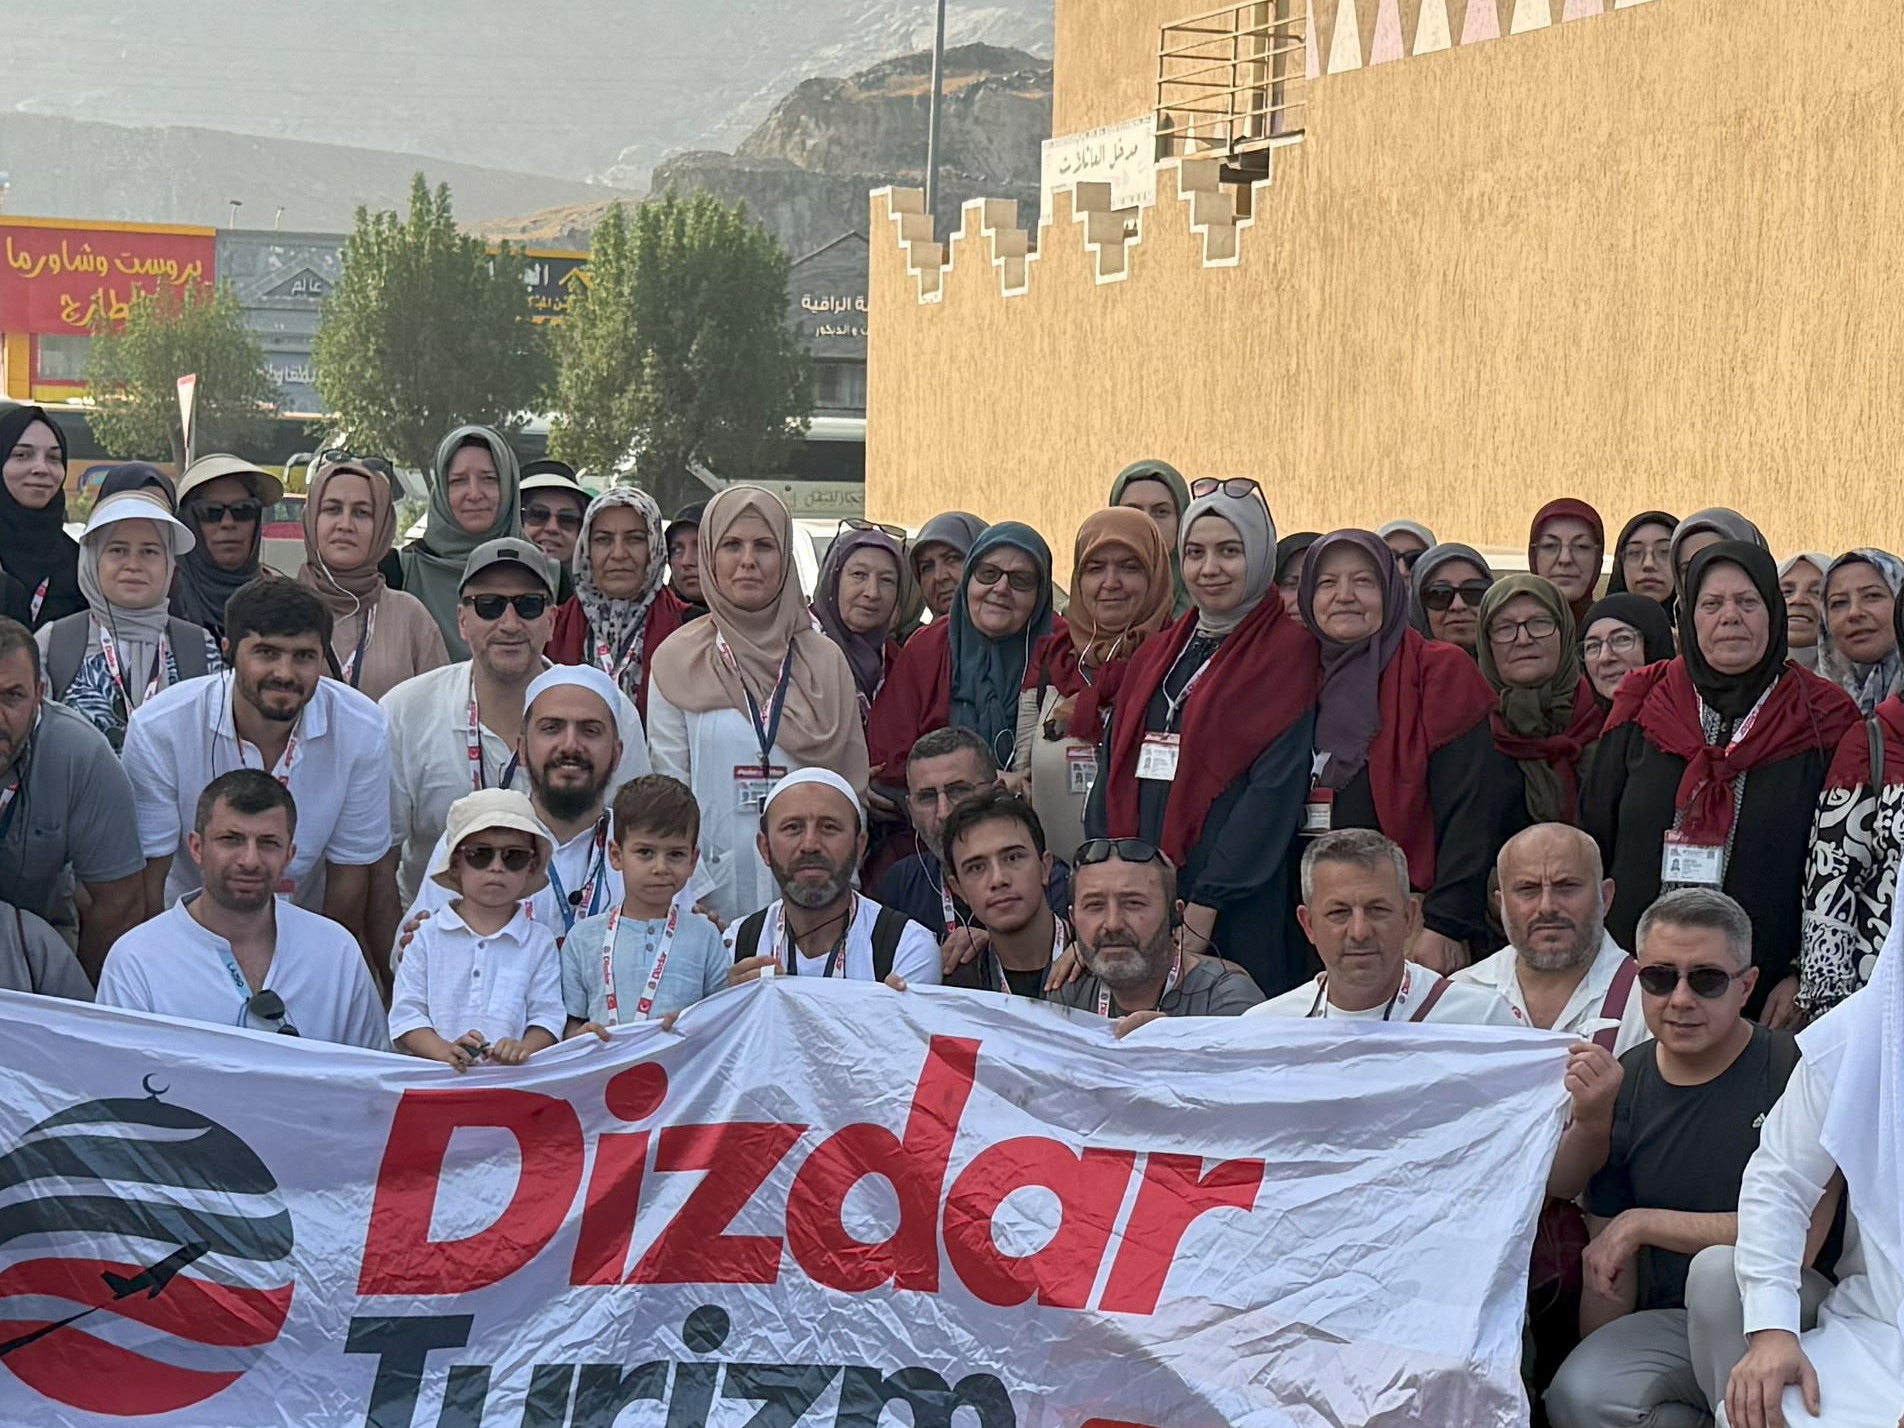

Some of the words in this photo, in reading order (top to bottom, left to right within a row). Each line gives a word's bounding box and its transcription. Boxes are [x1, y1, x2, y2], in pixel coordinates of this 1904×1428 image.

[6, 236, 108, 278] وشاورما
[114, 251, 203, 285] بروست
[800, 293, 851, 314] الراقية
[359, 1035, 1264, 1316] Dizdar
